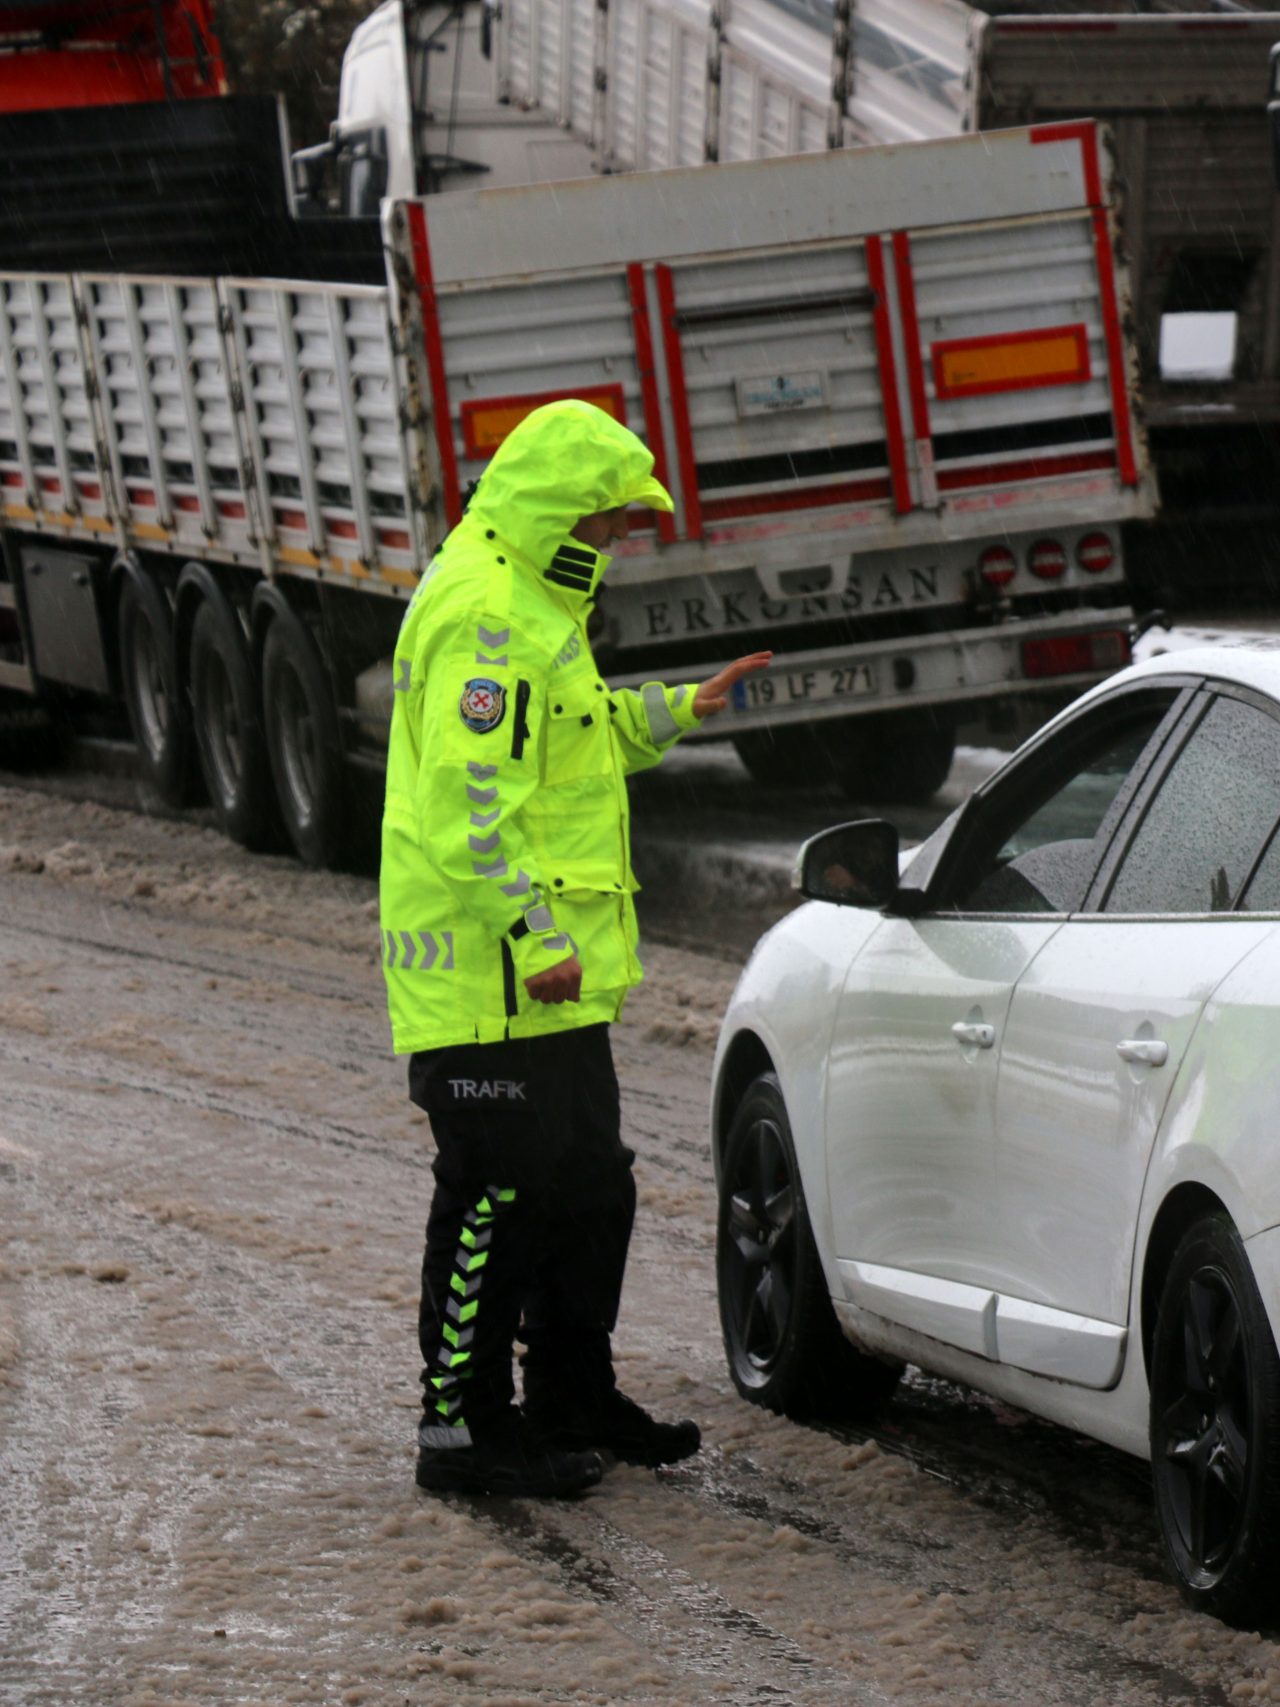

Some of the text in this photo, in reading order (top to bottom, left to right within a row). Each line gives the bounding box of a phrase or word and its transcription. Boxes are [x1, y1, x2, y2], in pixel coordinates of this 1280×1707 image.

[748, 664, 873, 705] 19 LF 271
